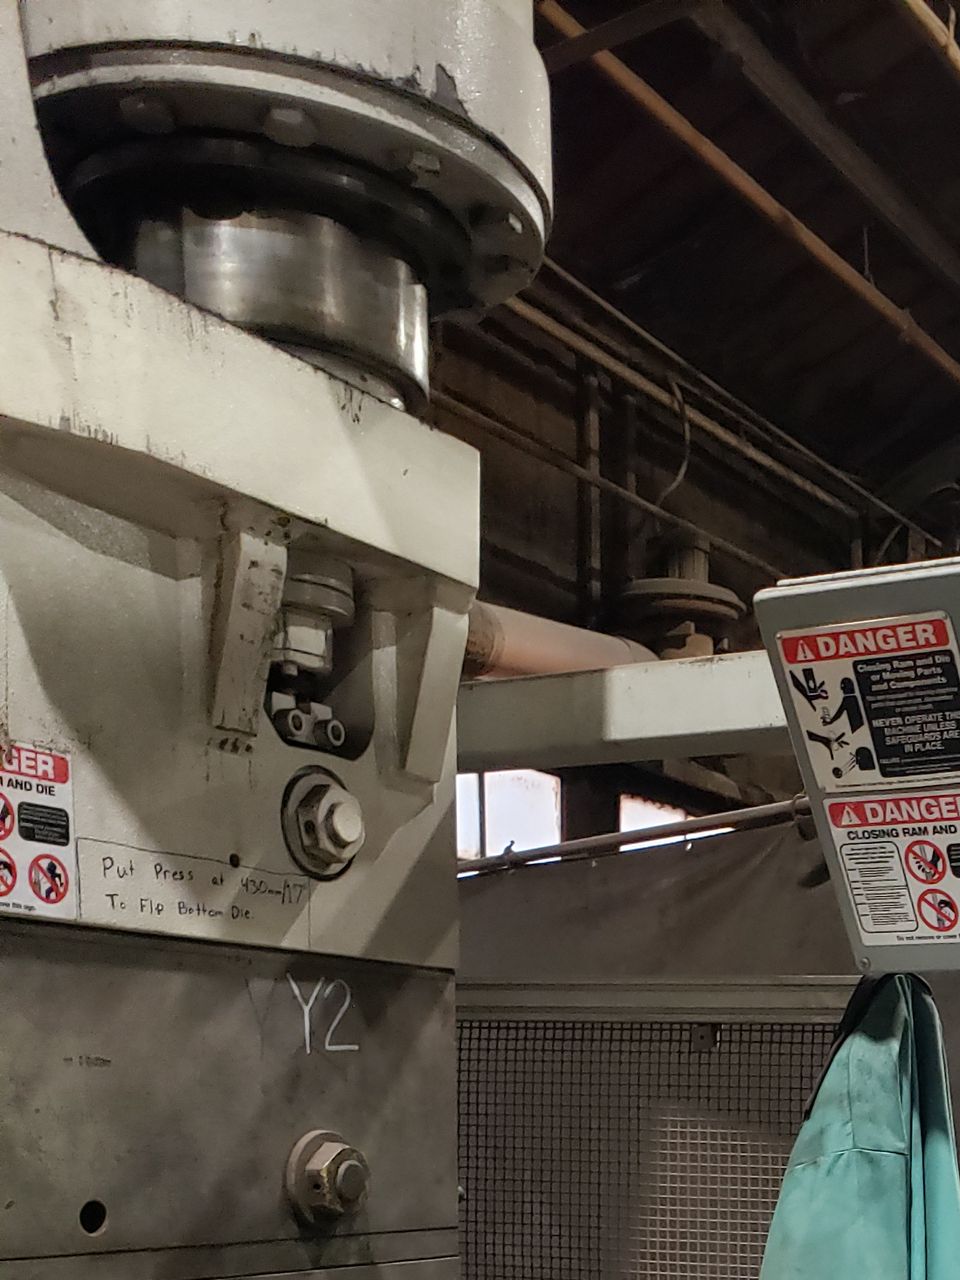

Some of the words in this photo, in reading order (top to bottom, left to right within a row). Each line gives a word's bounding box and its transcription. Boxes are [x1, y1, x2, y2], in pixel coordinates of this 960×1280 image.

[816, 623, 937, 657] DANGER
[917, 666, 942, 676] Parts
[872, 718, 902, 728] NEVER
[905, 713, 943, 725] OPERATE
[923, 721, 957, 732] UNLESS
[885, 733, 941, 745] SAFEGUARDS
[942, 730, 960, 739] ARE
[7, 778, 33, 792] AND
[36, 783, 56, 796] DIE
[847, 827, 899, 841] CLOSING
[902, 825, 929, 838] RAM
[932, 824, 957, 835] AND
[102, 856, 134, 880] Put
[153, 863, 195, 882] Press
[211, 875, 224, 887] at
[105, 893, 126, 911] To
[178, 901, 223, 919] Bottom
[286, 972, 360, 1055] Y2
